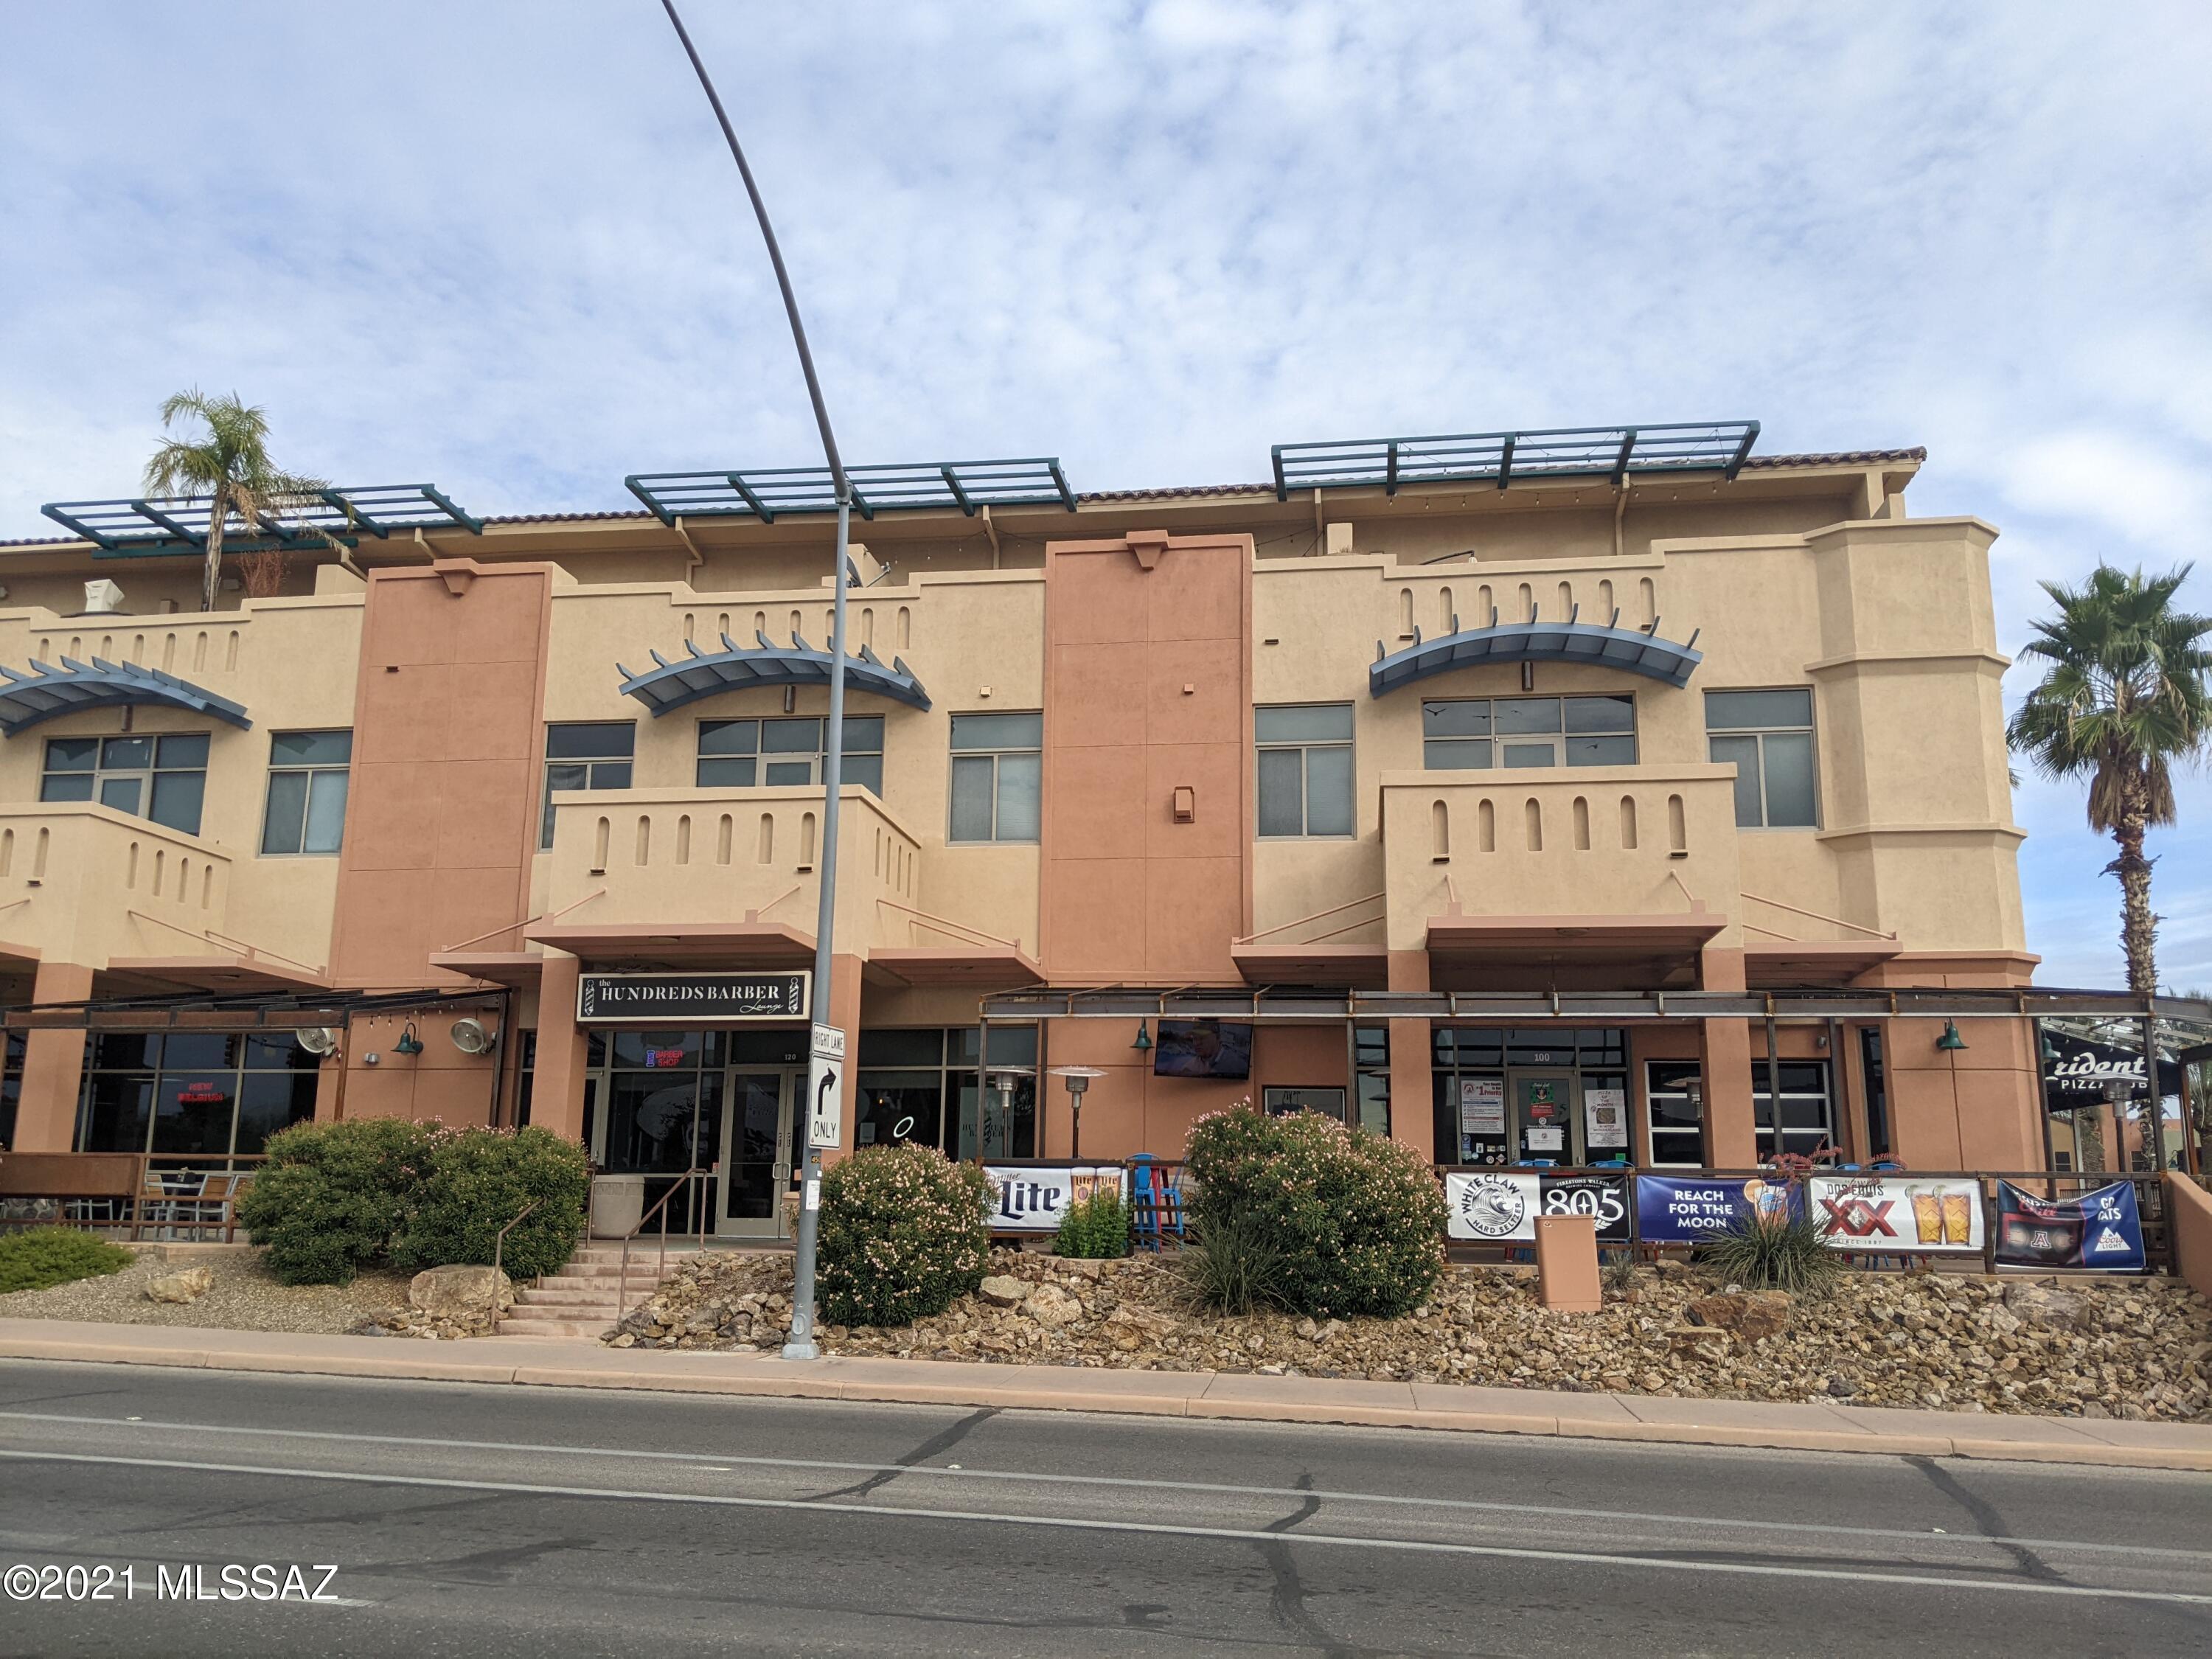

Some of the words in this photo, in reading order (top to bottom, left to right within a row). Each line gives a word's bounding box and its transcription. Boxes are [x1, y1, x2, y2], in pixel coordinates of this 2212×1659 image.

[740, 999, 784, 1014] Lounge
[815, 1031, 830, 1047] RIGHT
[831, 1034, 844, 1051] LANE
[655, 1050, 684, 1058] BARBER
[1534, 1053, 1550, 1062] 100
[658, 1058, 679, 1067] SHOP
[2045, 1052, 2146, 1080] rident
[813, 1121, 838, 1139] ONLY
[1076, 1176, 1092, 1186] Lite
[1557, 1179, 1587, 1187] FIRESTONE
[1587, 1179, 1610, 1187] WALKER
[1461, 1178, 1483, 1214] WHITE
[1484, 1174, 1520, 1194] CLAW
[1674, 1190, 1724, 1201] REACH
[1000, 1181, 1060, 1220] Lite
[1545, 1189, 1624, 1222] 805
[2101, 1197, 2115, 1208] GO
[1669, 1203, 1700, 1214] FOR
[1703, 1204, 1733, 1214] THE
[1473, 1220, 1496, 1234] HARD
[1499, 1203, 1522, 1233] SELTZER
[1677, 1217, 1728, 1228] MOON
[1818, 1199, 1899, 1237] XX
[2099, 1235, 2124, 1243] Coors
